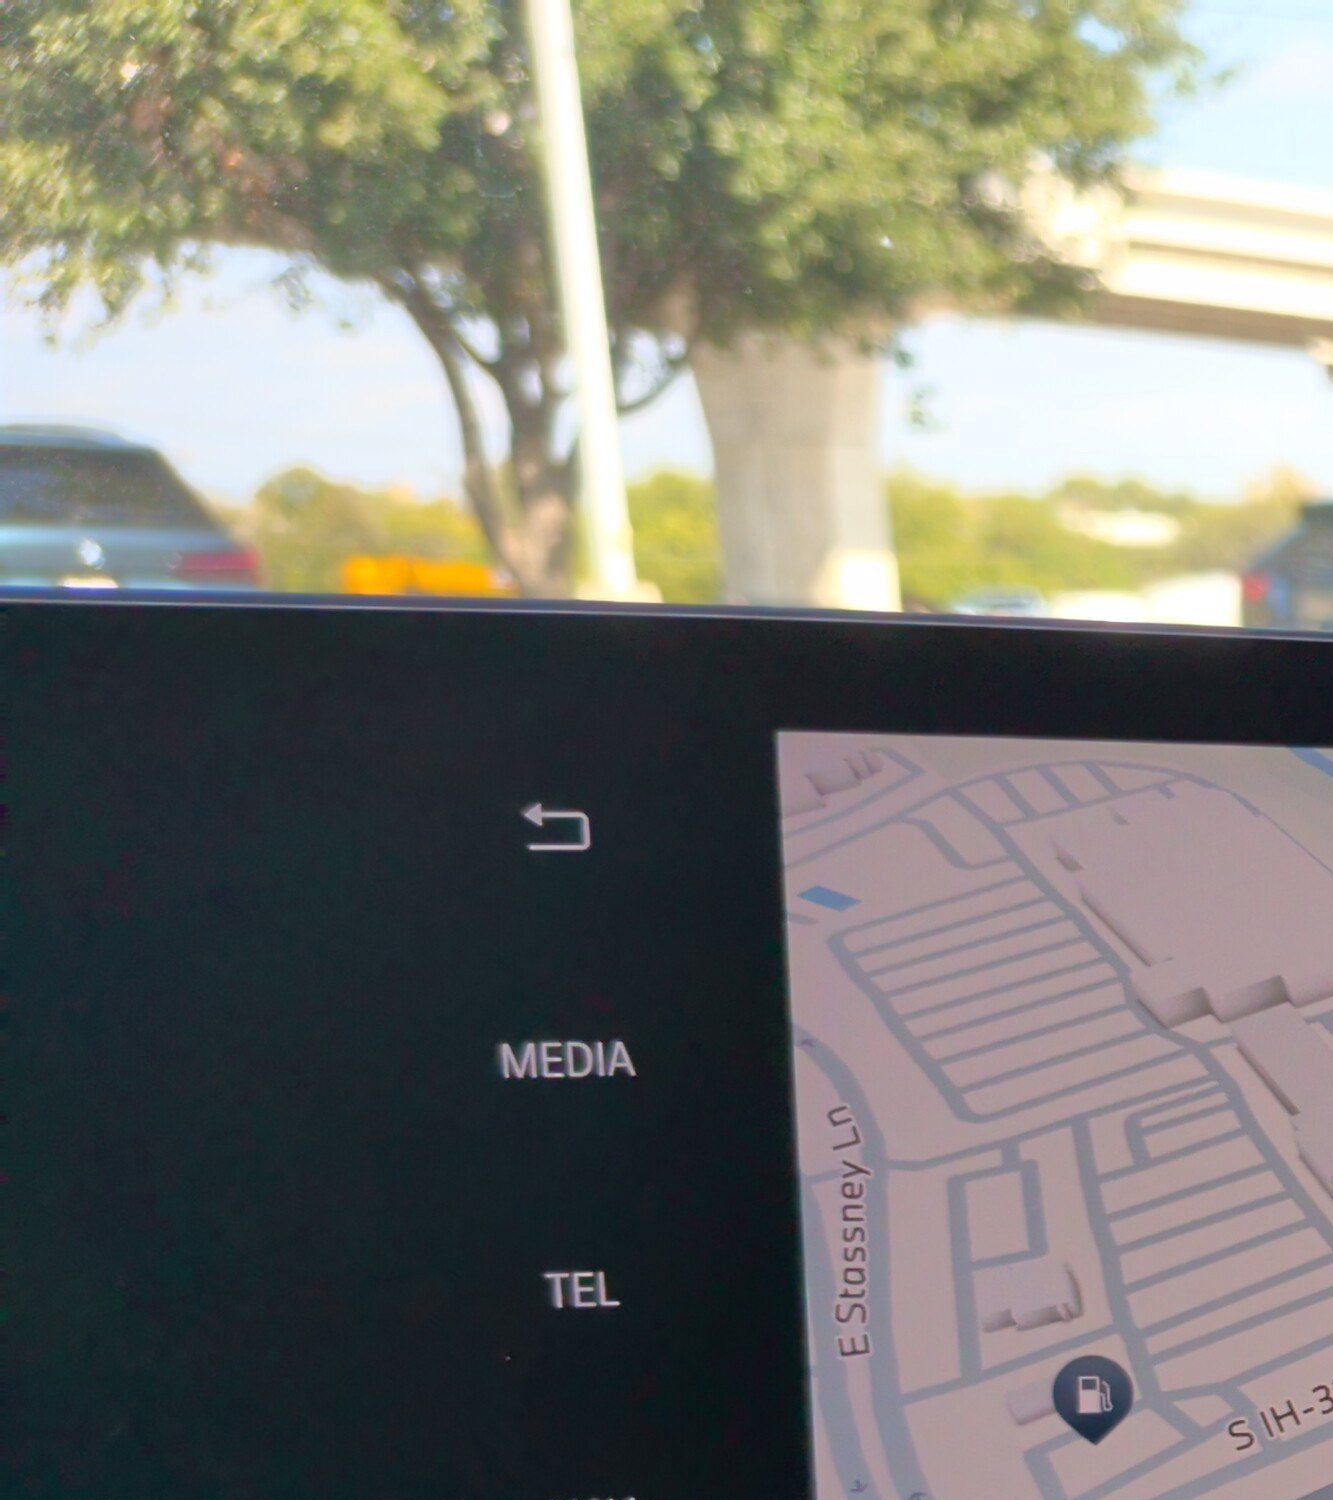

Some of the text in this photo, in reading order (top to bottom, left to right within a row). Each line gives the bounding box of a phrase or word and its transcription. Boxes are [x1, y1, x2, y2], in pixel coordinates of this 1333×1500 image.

[499, 1040, 638, 1079] MEDIA
[827, 1104, 872, 1358] E Stassney Ln
[543, 1270, 621, 1309] TEL
[1227, 1419, 1255, 1451] S
